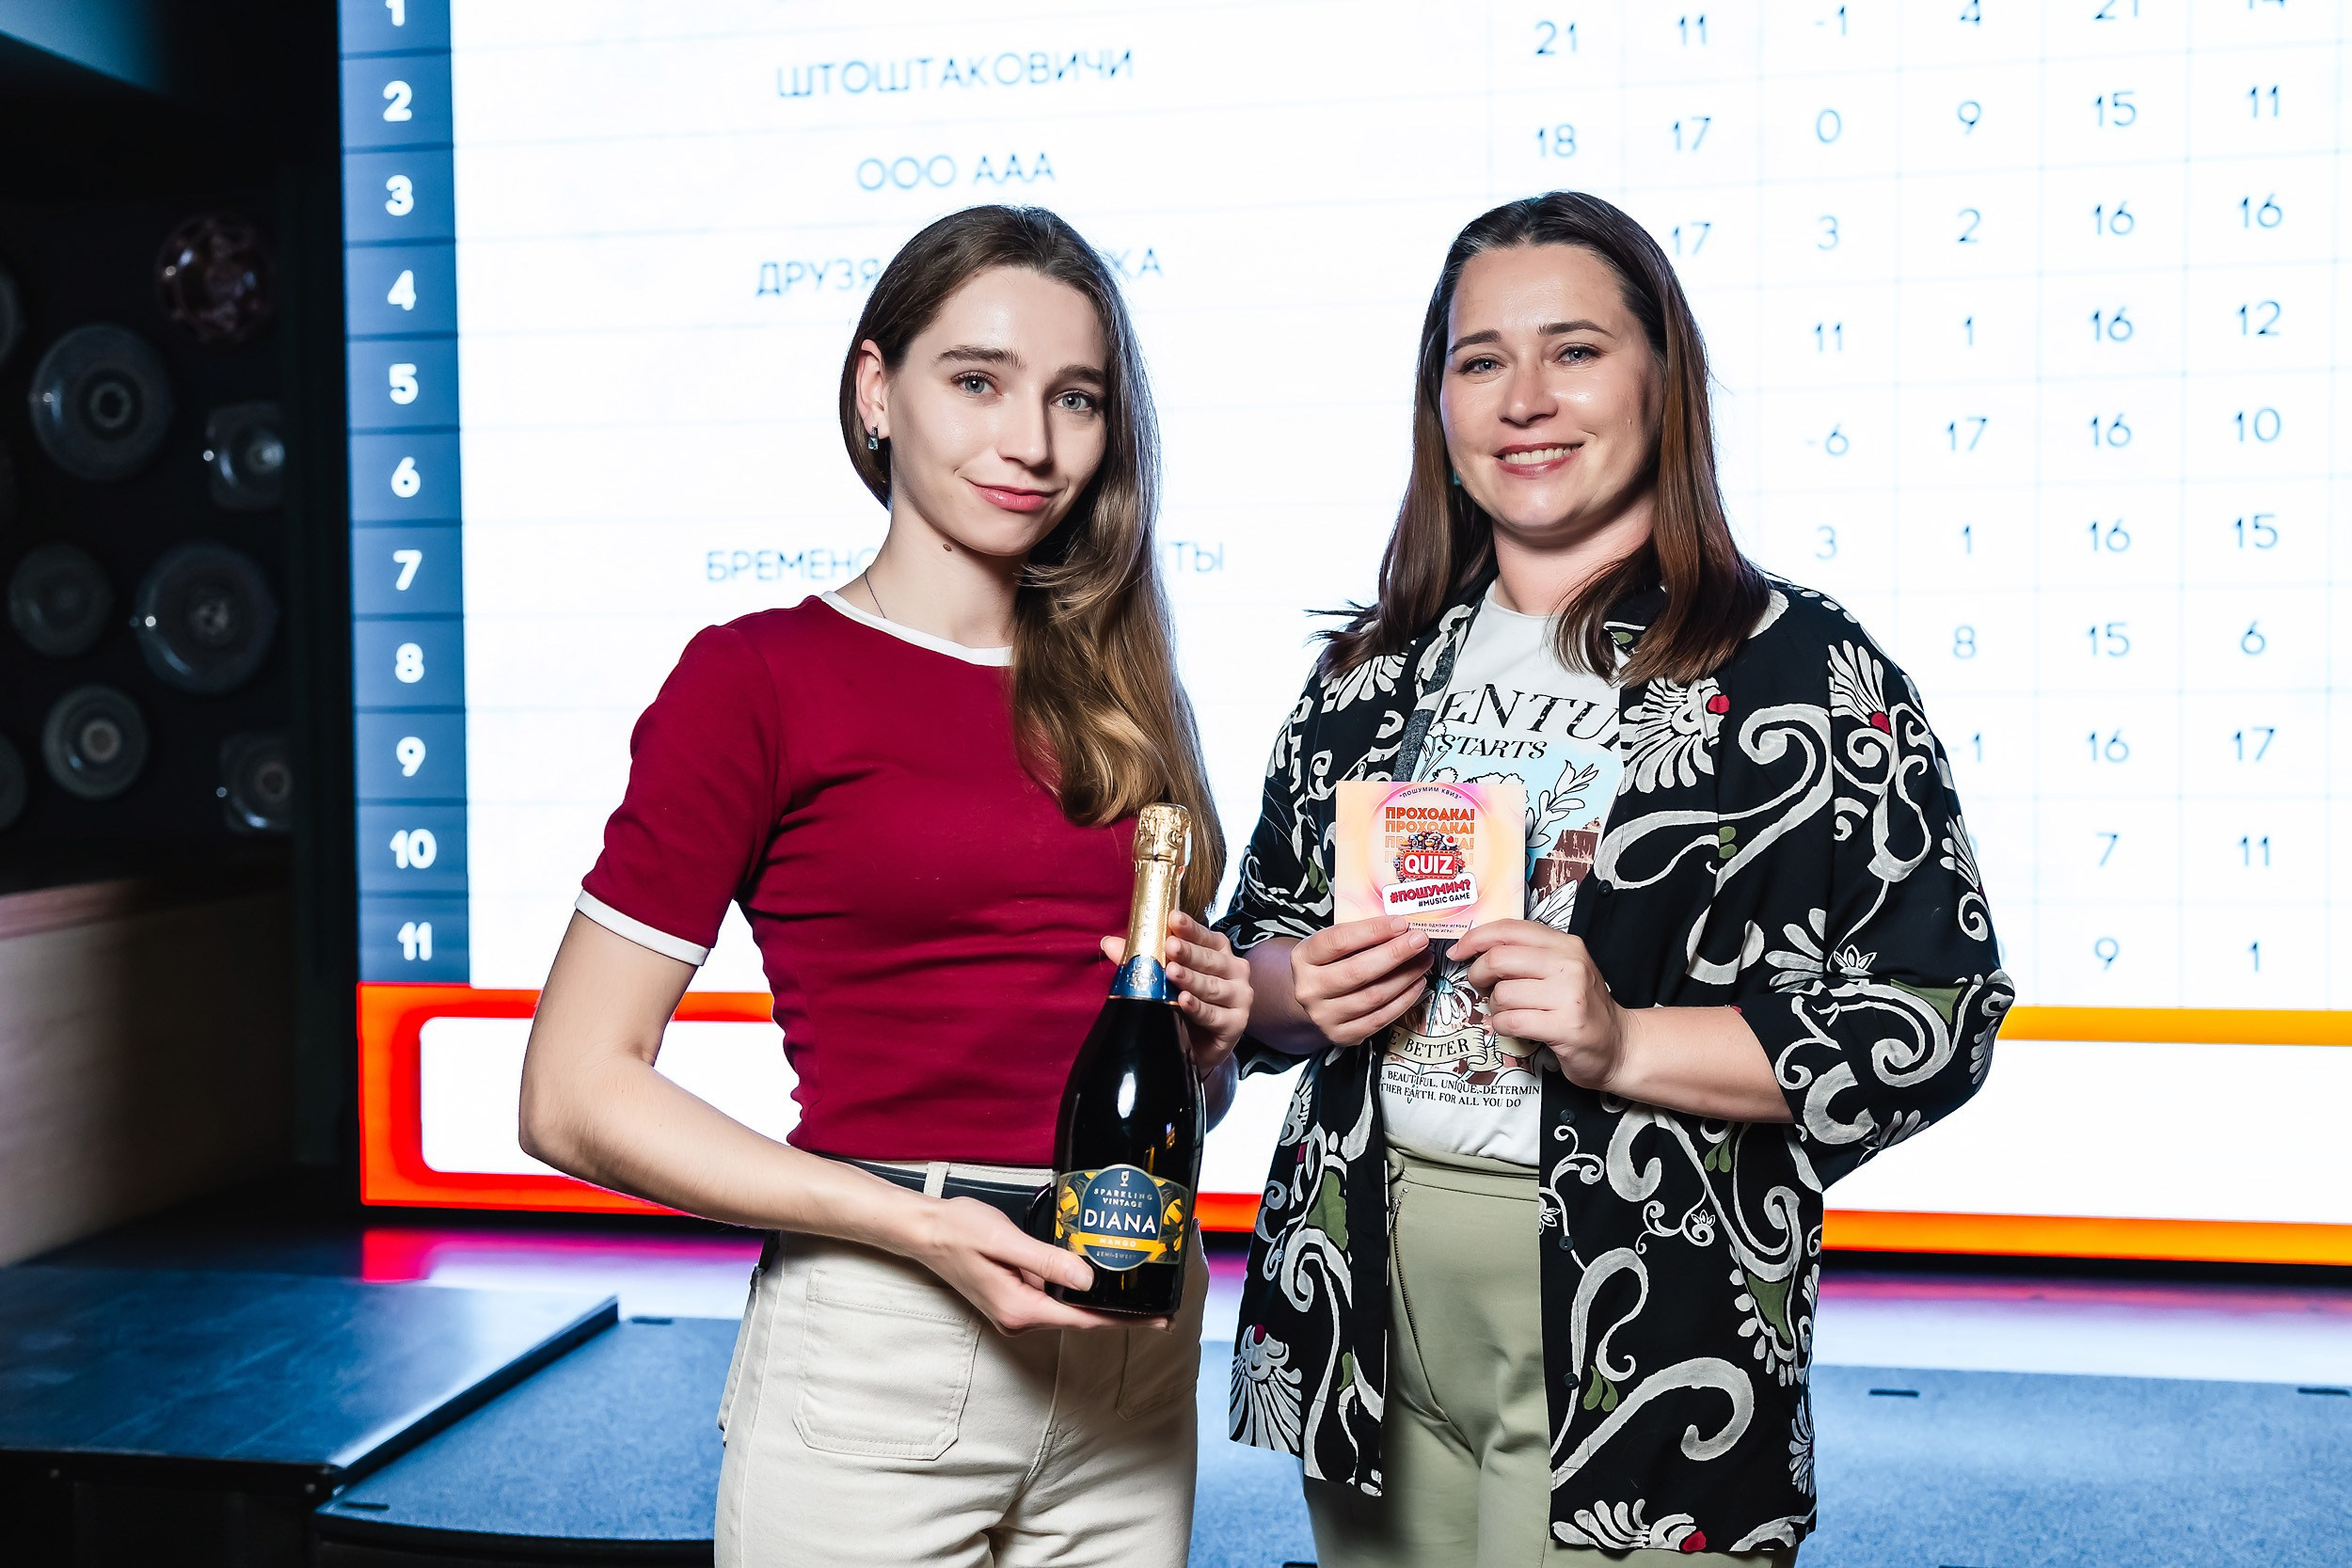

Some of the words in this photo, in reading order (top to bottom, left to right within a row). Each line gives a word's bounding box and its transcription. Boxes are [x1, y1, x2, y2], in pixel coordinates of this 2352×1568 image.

[1677, 13, 1707, 45] 11
[1814, 4, 1847, 35] -1
[1534, 20, 1578, 56] 21
[777, 50, 1132, 99] ШТОШТАКОВИЧИ
[384, 81, 411, 121] 2
[1957, 101, 1982, 135] 9
[2092, 91, 2137, 127] 15
[2248, 85, 2280, 119] 11
[1536, 123, 1577, 158] 18
[1672, 116, 1712, 151] 17
[1816, 108, 1842, 144] 0
[974, 151, 1056, 184] ААА
[386, 175, 413, 215] 3
[2238, 194, 2283, 230] 16
[1818, 214, 1839, 250] 3
[1957, 208, 1981, 244] 2
[2092, 200, 2136, 236] 16
[1671, 221, 1712, 258] 17
[388, 271, 416, 310] 4
[1963, 315, 1974, 346] 1
[2090, 306, 2135, 343] 16
[2235, 300, 2282, 338] 12
[1813, 322, 1843, 352] 11
[389, 364, 418, 404] 5
[1806, 424, 1850, 456] -6
[1946, 416, 1989, 451] 17
[2090, 413, 2133, 449] 16
[2233, 407, 2282, 443] 10
[391, 457, 420, 498] 6
[1816, 525, 1837, 559] 3
[1962, 524, 1972, 554] 1
[2089, 518, 2131, 553] 16
[2233, 513, 2279, 549] 15
[393, 550, 421, 591] 7
[1952, 626, 1977, 658] 8
[2087, 622, 2131, 657] 15
[2239, 620, 2266, 656] 6
[395, 643, 423, 683] 8
[1437, 684, 1620, 752] ENTU
[397, 736, 425, 777] 9
[1438, 734, 1548, 759] STARTS
[2088, 729, 2131, 763] 16
[2232, 727, 2277, 762] 17
[1385, 806, 1474, 821] ПРОХОДКА!
[390, 830, 436, 869] 10
[1405, 854, 1454, 875] QUIZ
[2097, 832, 2120, 866] 7
[2238, 834, 2270, 867] 11
[1390, 879, 1470, 904] #ПОШУМИМ?
[1418, 895, 1448, 908] #MUSIC
[1449, 892, 1470, 902] GAME
[398, 923, 432, 960] 11
[2093, 937, 2121, 971] 9
[2248, 940, 2260, 973] 1
[1404, 1038, 1470, 1058] BETTER
[1379, 1083, 1402, 1096] THER
[1439, 1093, 1456, 1104] FOR
[1458, 1097, 1480, 1106] ALL
[1483, 1098, 1503, 1107] YOU
[1506, 1099, 1521, 1108] DO
[1483, 1085, 1540, 1095] DETERMIN
[1093, 1188, 1152, 1201] SPARKLING
[1103, 1197, 1143, 1209] VINTAGE
[1084, 1209, 1156, 1234] DIANA
[1099, 1238, 1136, 1247] MANGO
